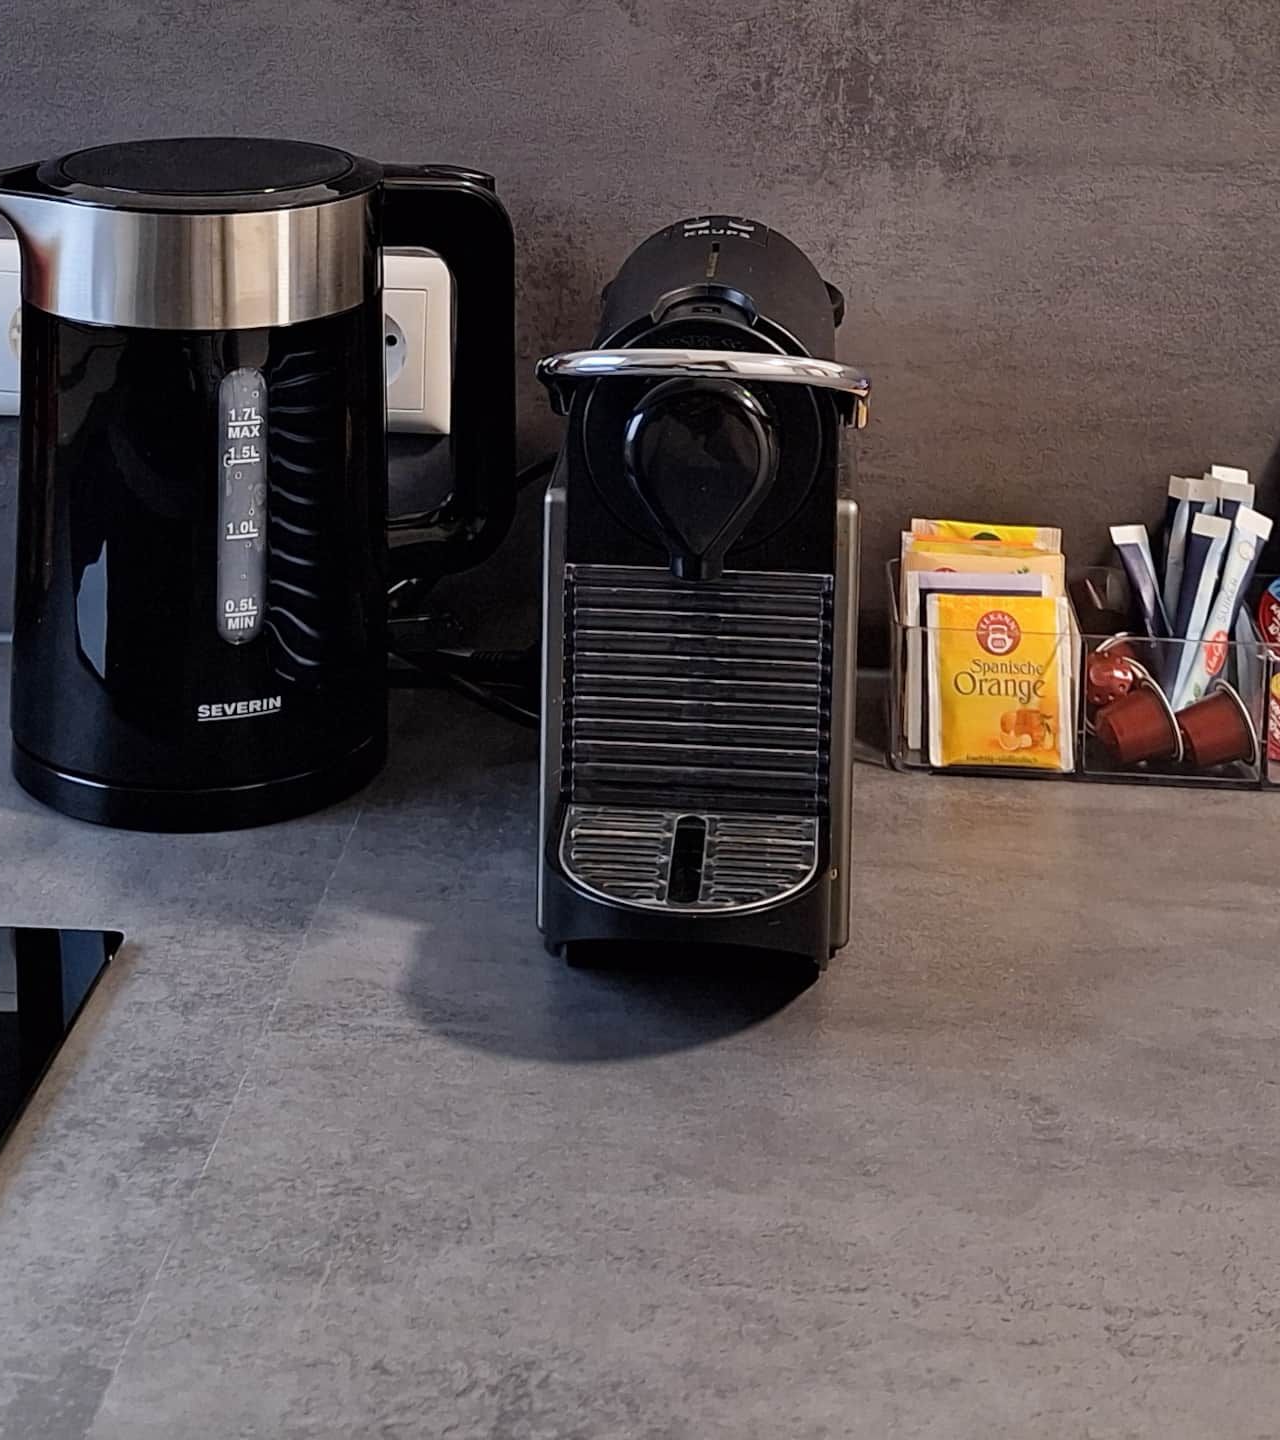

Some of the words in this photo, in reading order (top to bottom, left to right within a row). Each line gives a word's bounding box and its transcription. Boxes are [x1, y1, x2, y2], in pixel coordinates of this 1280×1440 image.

[228, 407, 260, 421] 1.7L
[228, 425, 260, 439] MAX
[227, 520, 258, 534] 1.0L
[225, 598, 257, 612] 0.5L
[228, 616, 254, 630] MIN
[971, 659, 1045, 677] Spanische
[954, 671, 1046, 704] Orange
[197, 696, 282, 718] SEVERIN
